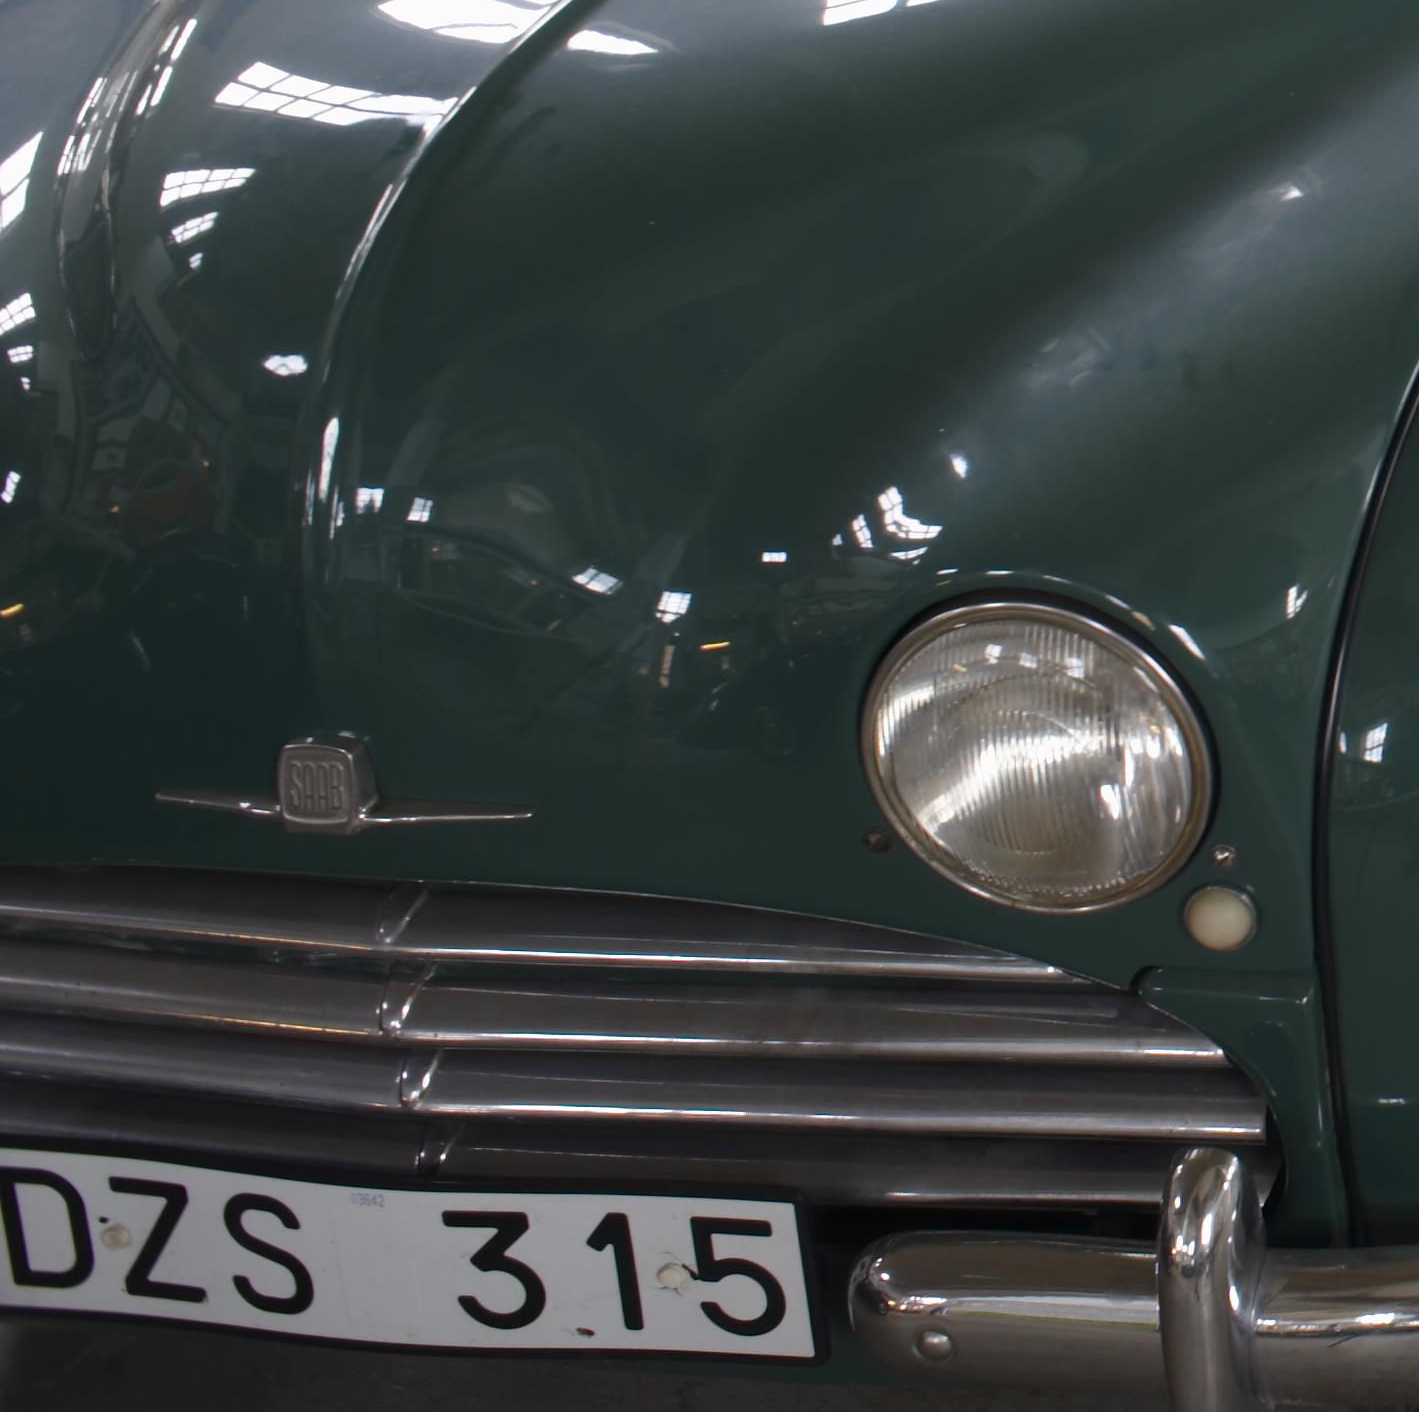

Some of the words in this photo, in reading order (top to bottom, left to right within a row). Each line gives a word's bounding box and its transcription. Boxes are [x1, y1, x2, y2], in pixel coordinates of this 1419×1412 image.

[289, 761, 344, 811] SAAB
[0, 1168, 314, 1315] DZS
[441, 1210, 787, 1337] 315
